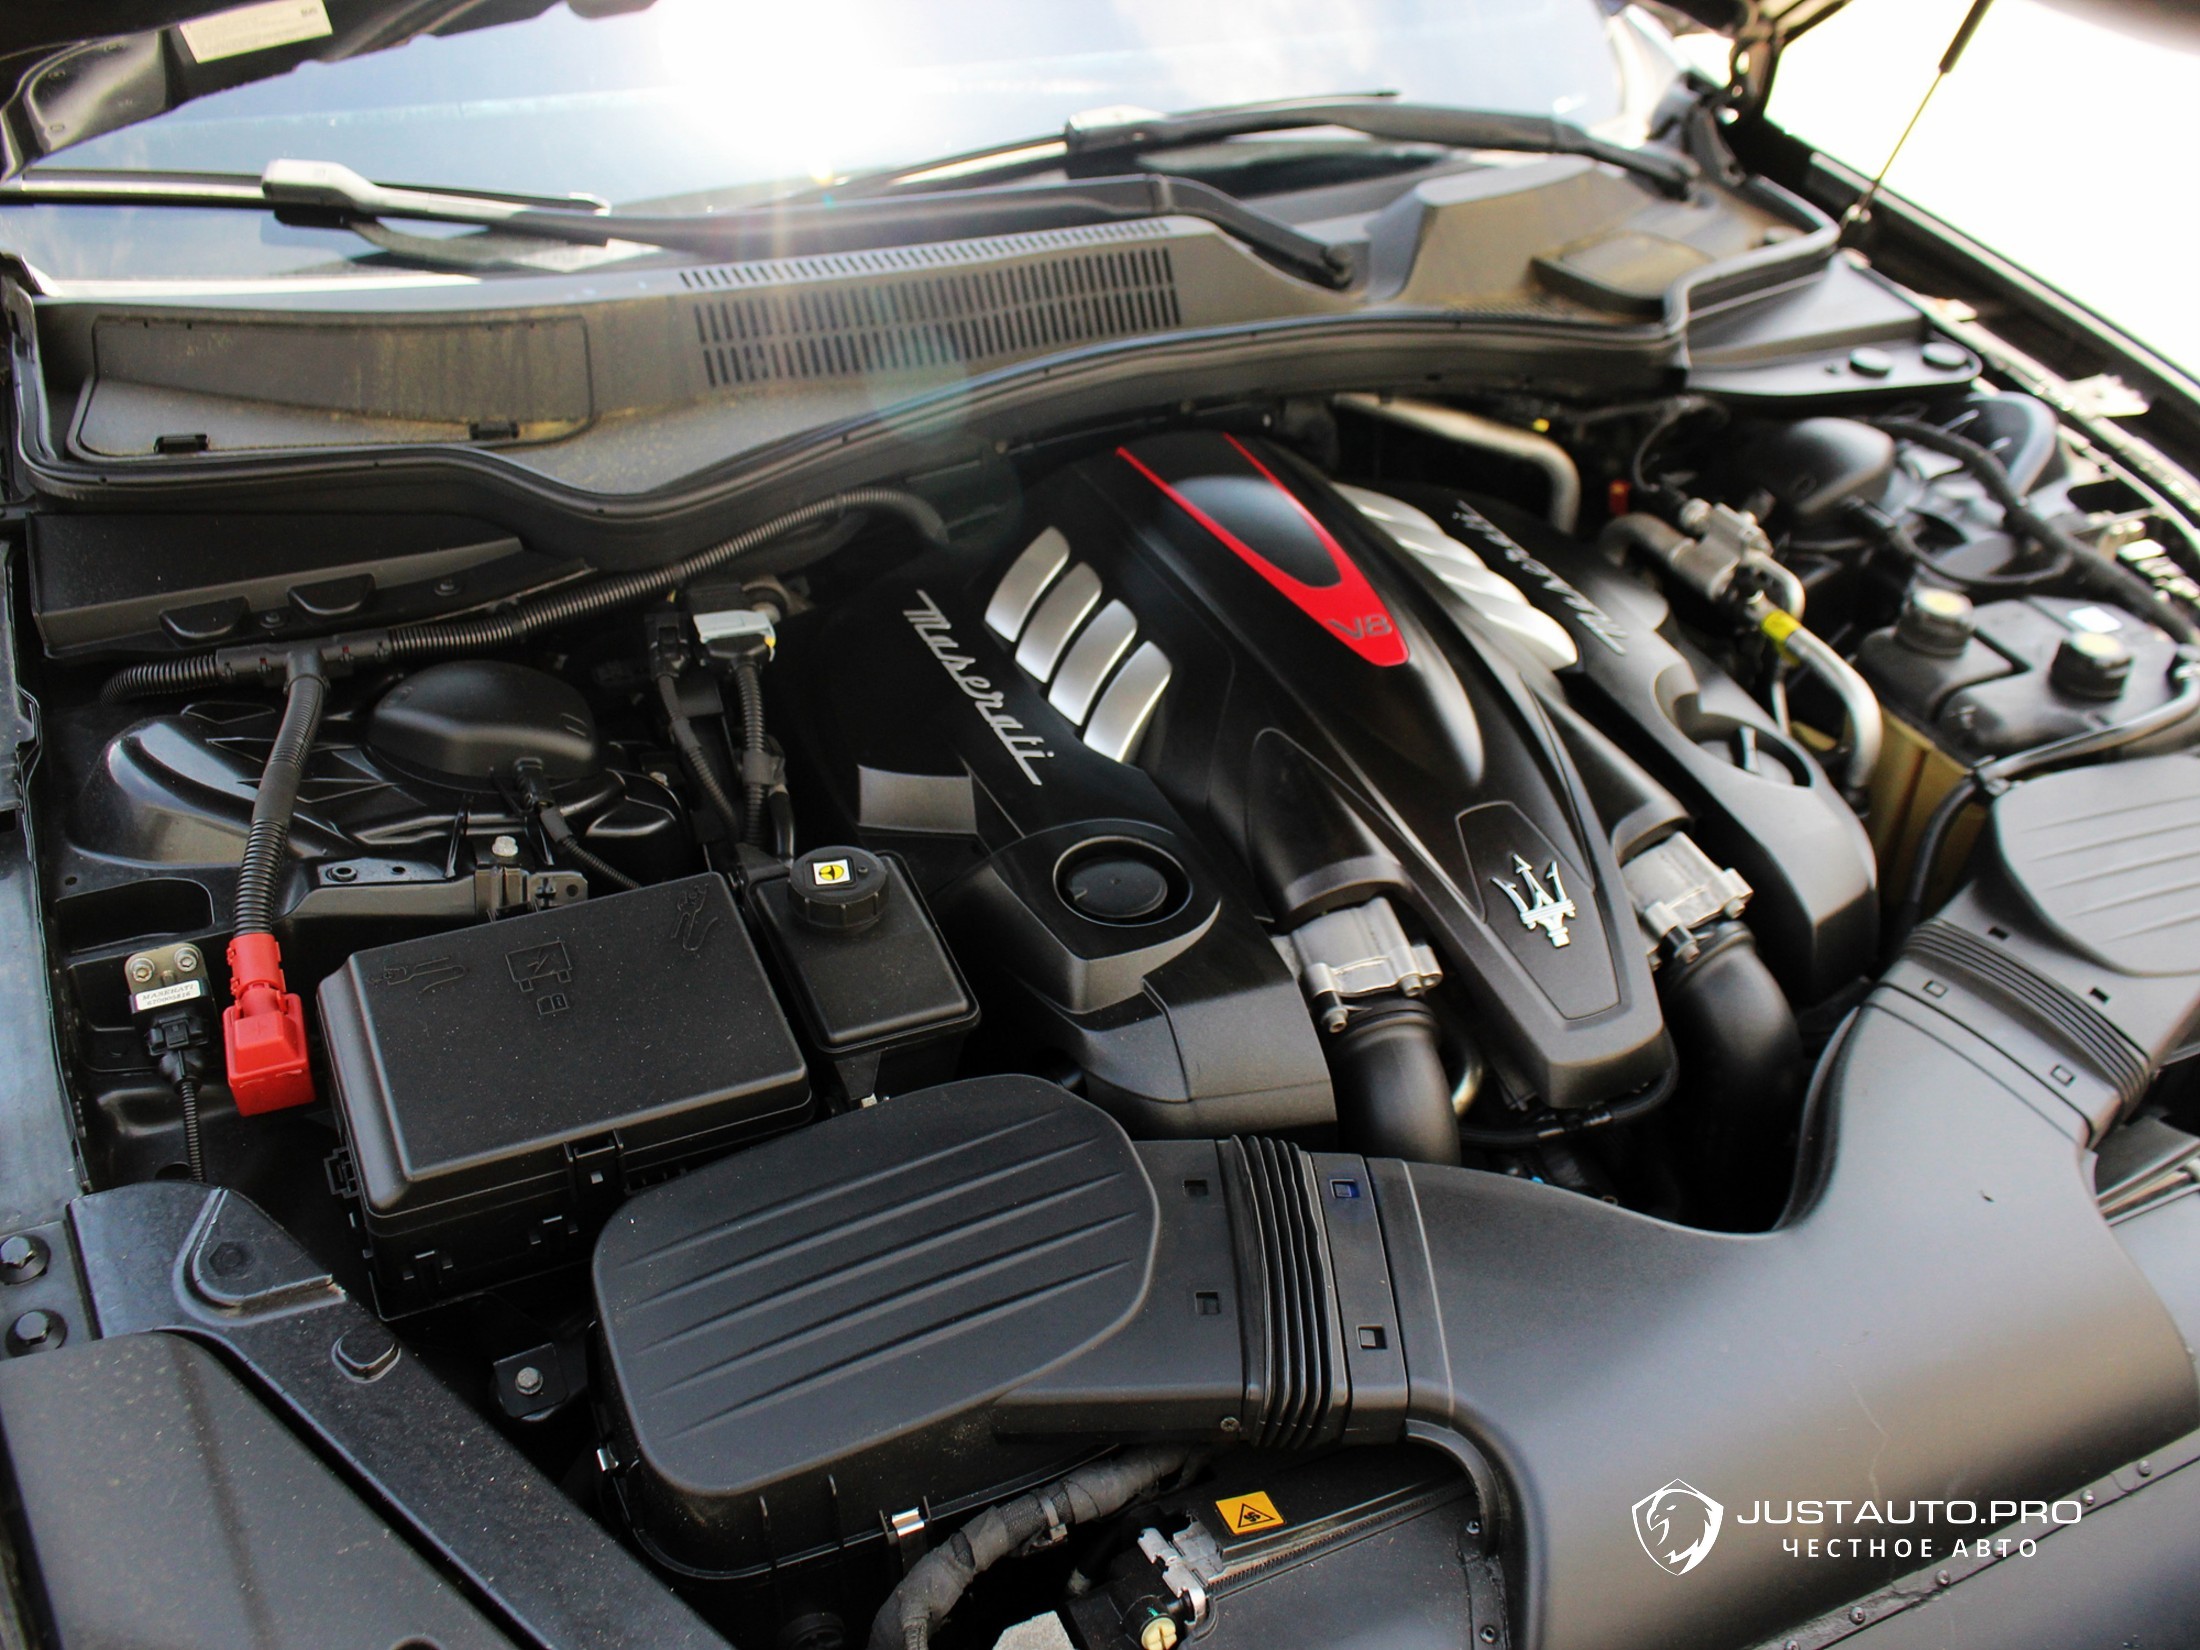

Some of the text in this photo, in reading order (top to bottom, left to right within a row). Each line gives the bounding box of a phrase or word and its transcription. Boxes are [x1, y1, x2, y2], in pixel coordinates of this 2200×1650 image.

[1326, 613, 1393, 640] V8
[902, 588, 1055, 786] Maserati
[142, 983, 194, 1000] MASERATI
